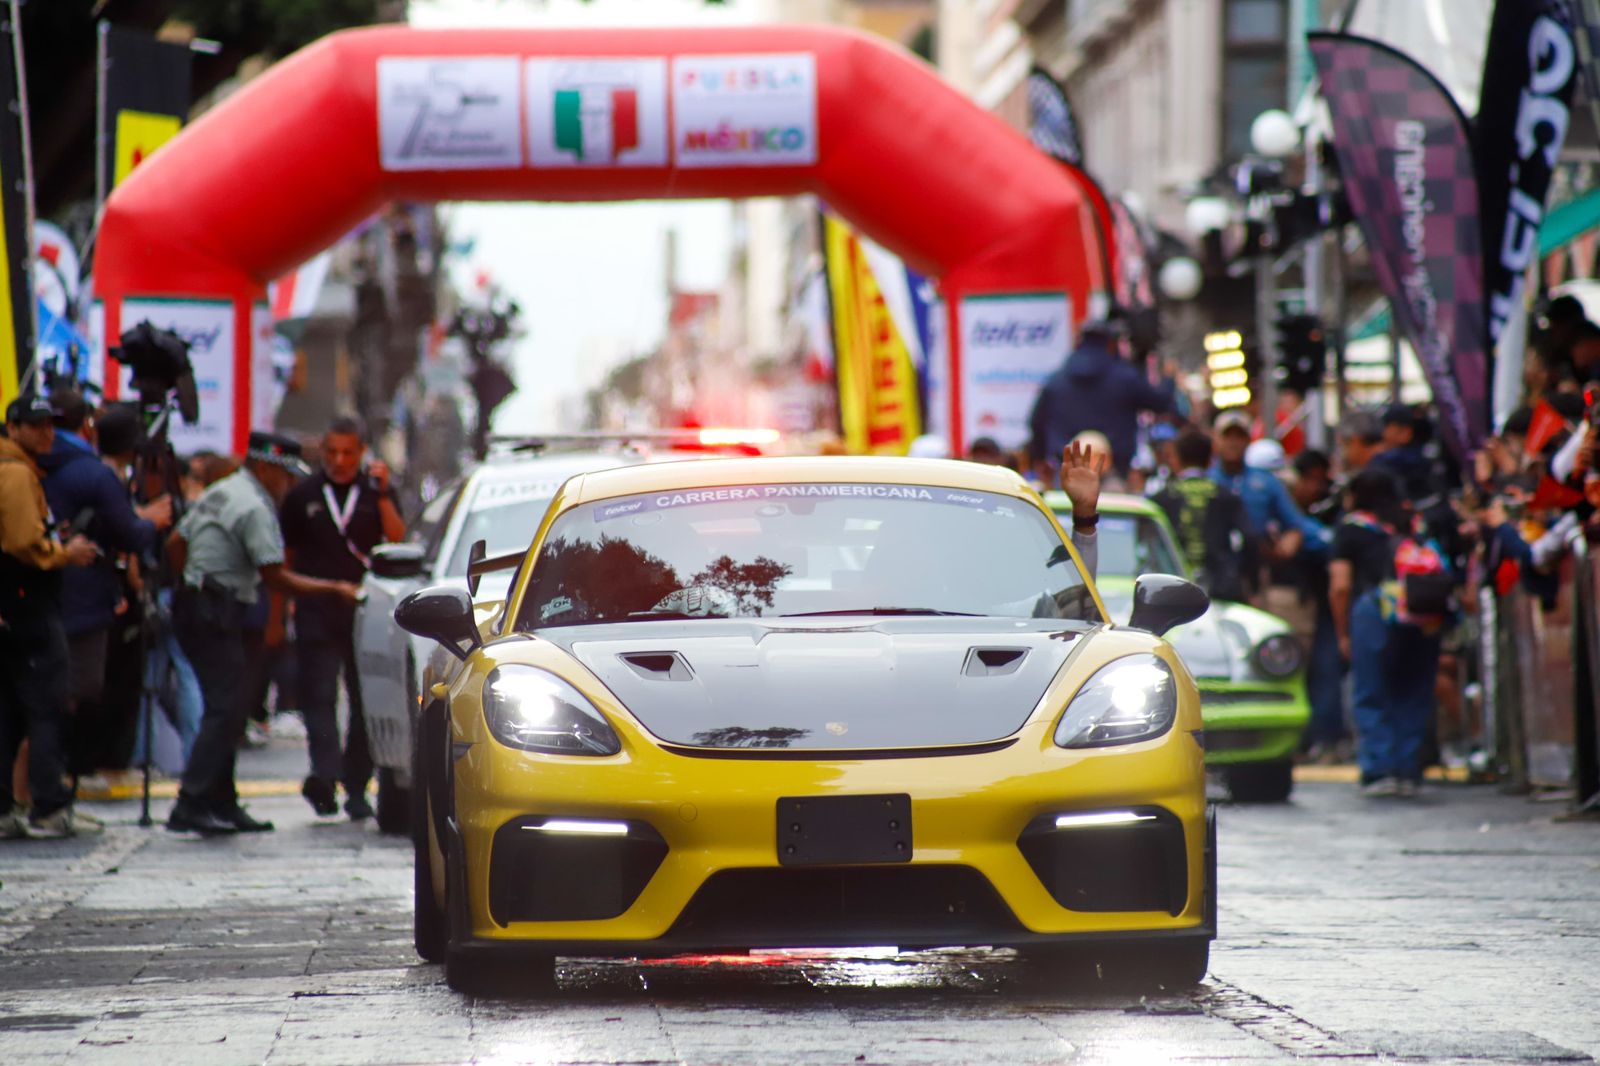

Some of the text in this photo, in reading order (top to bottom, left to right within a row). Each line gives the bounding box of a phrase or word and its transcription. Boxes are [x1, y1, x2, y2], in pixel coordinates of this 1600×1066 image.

[604, 484, 984, 516] telcel CARRERA PANAMERICANA telcel
